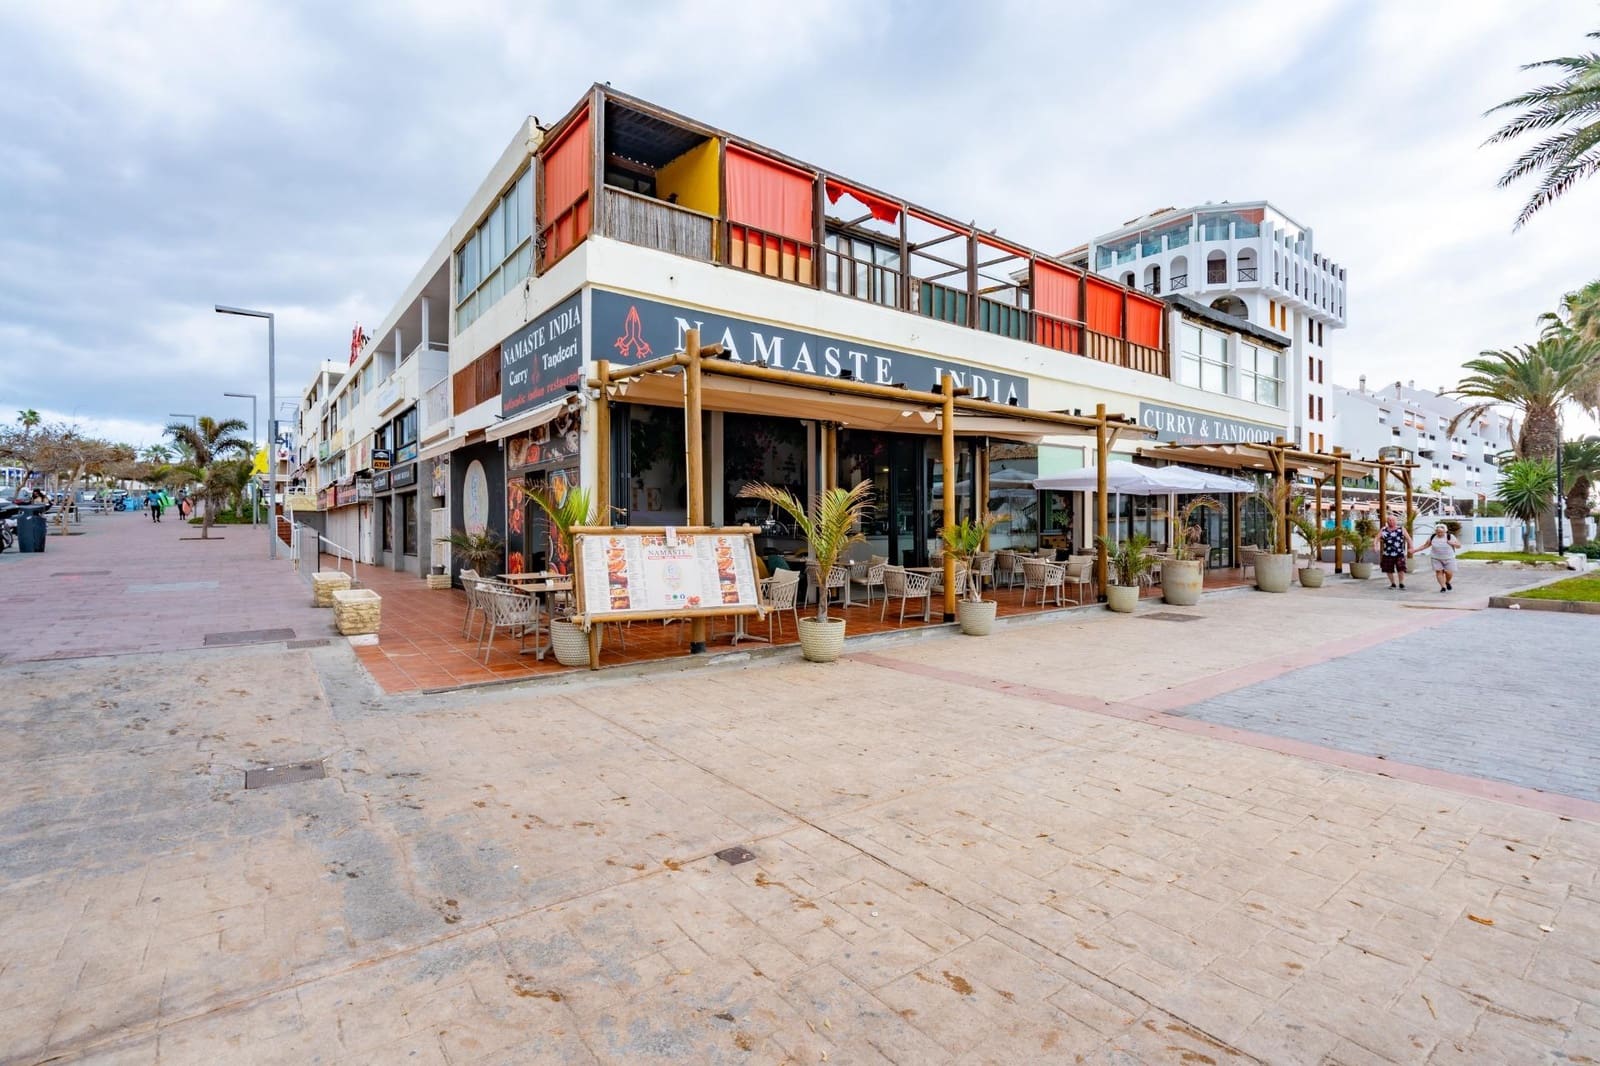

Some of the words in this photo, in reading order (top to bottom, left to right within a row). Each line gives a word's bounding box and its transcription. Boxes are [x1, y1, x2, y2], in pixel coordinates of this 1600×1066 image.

[503, 326, 546, 368] NAMASTE
[549, 304, 582, 341] INDIA
[674, 316, 893, 385] NAMASTE
[933, 366, 1020, 407] INDIA
[1144, 409, 1196, 435] CURRY
[1199, 419, 1209, 438] &
[1213, 421, 1275, 443] TANDOORI
